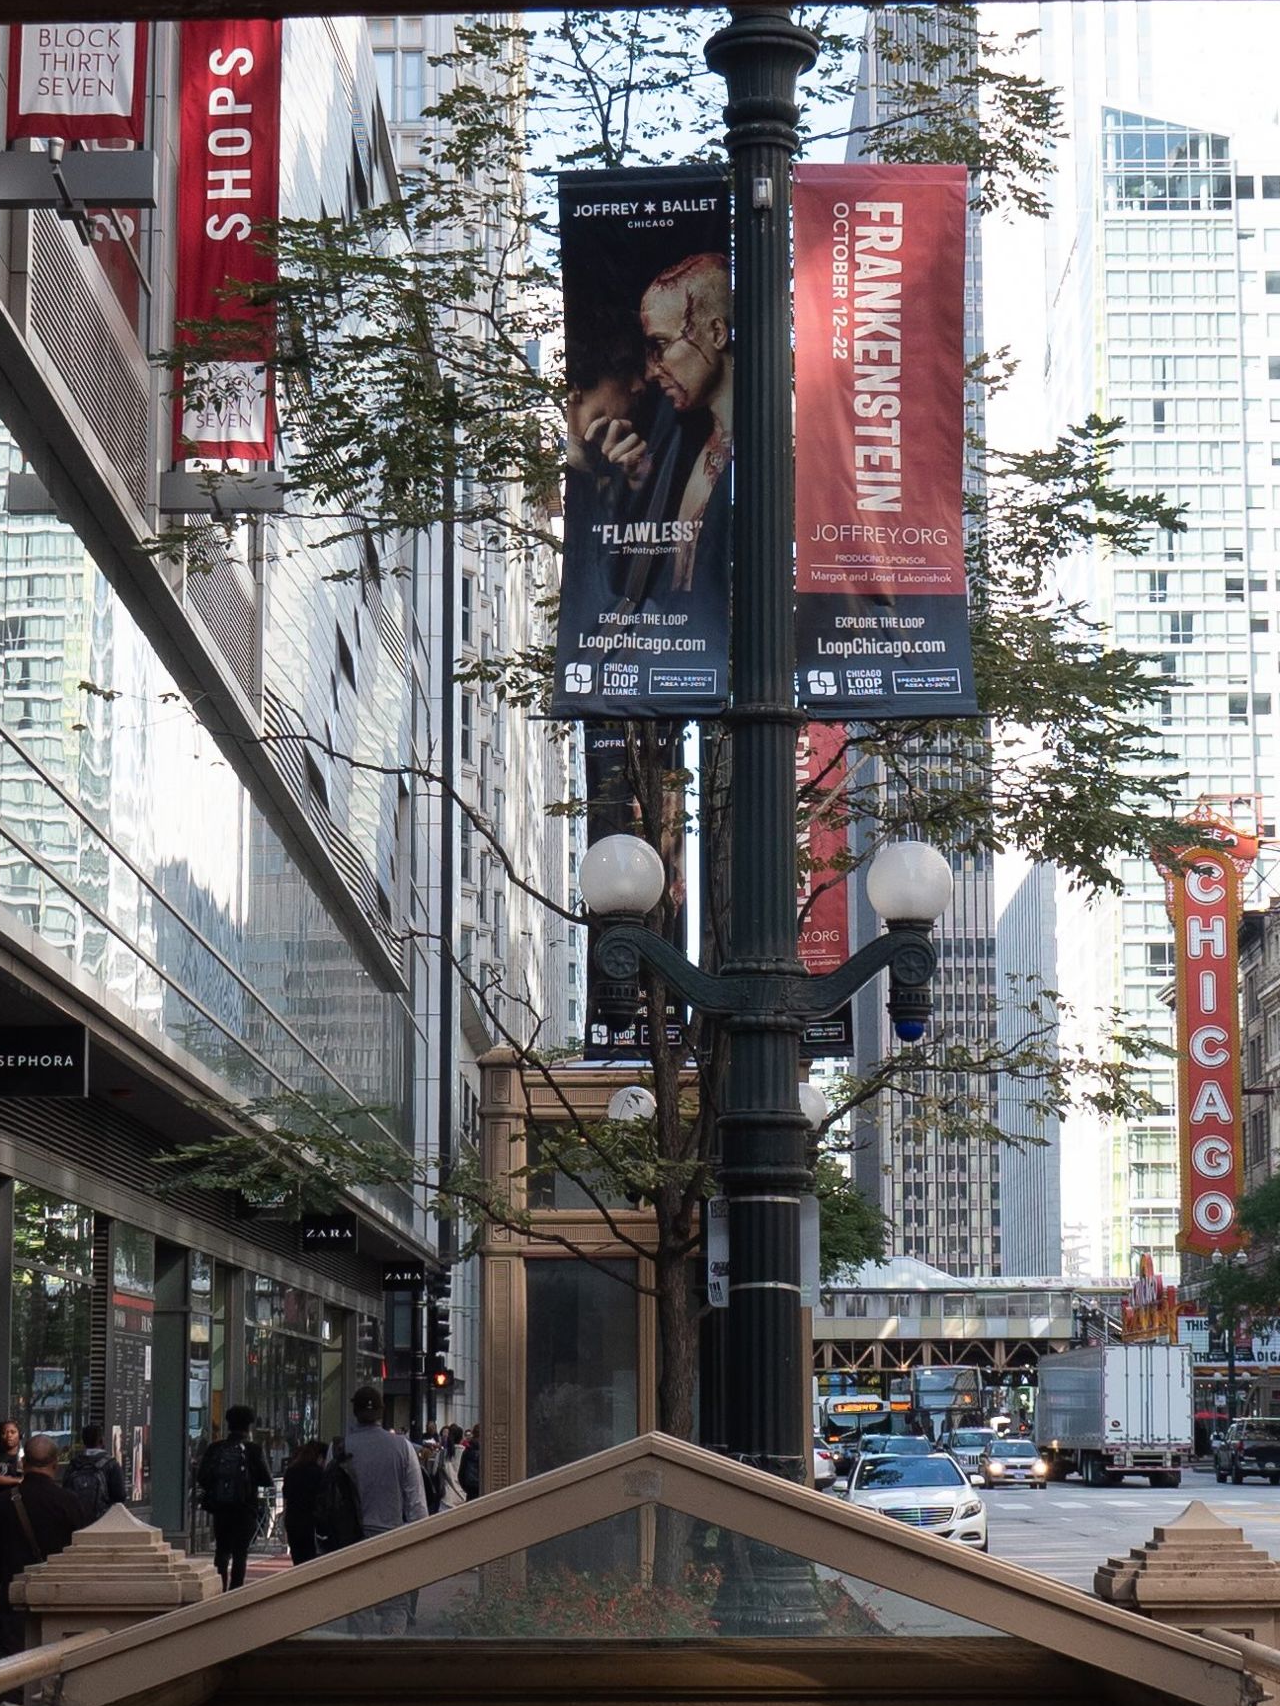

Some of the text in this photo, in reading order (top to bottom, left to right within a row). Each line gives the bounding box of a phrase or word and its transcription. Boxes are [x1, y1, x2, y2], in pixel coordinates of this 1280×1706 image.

[39, 28, 121, 48] BLOCK
[38, 52, 120, 73] THIRTY
[37, 77, 115, 97] SEVEN
[206, 47, 254, 242] SHOPS
[573, 198, 718, 218] JOFFREY BALLET
[627, 219, 674, 229] CHICAGO
[832, 202, 850, 299] OCTOBER
[853, 201, 904, 513] FRANKENSTEIN
[196, 413, 252, 429] SEVEN
[811, 524, 949, 545] JOFFREY.ORG
[835, 554, 927, 565] PRODUCING SPONSOR
[811, 571, 952, 583] Margot and Josef Lakonishok
[598, 613, 689, 626] EXPLORE THE LOOP
[835, 616, 925, 629] EXPLORE THE LOOP
[578, 633, 706, 655] LoopChicago.com
[818, 637, 946, 659] LoopChicago.com
[603, 663, 639, 674] CHICAGO
[846, 669, 882, 678] CHICAGO
[604, 673, 639, 688] LOOP
[847, 678, 883, 688] LOOP
[1185, 861, 1236, 1235] CHICAGO
[306, 1229, 353, 1238] ZARA
[1185, 1320, 1209, 1331] THIS
